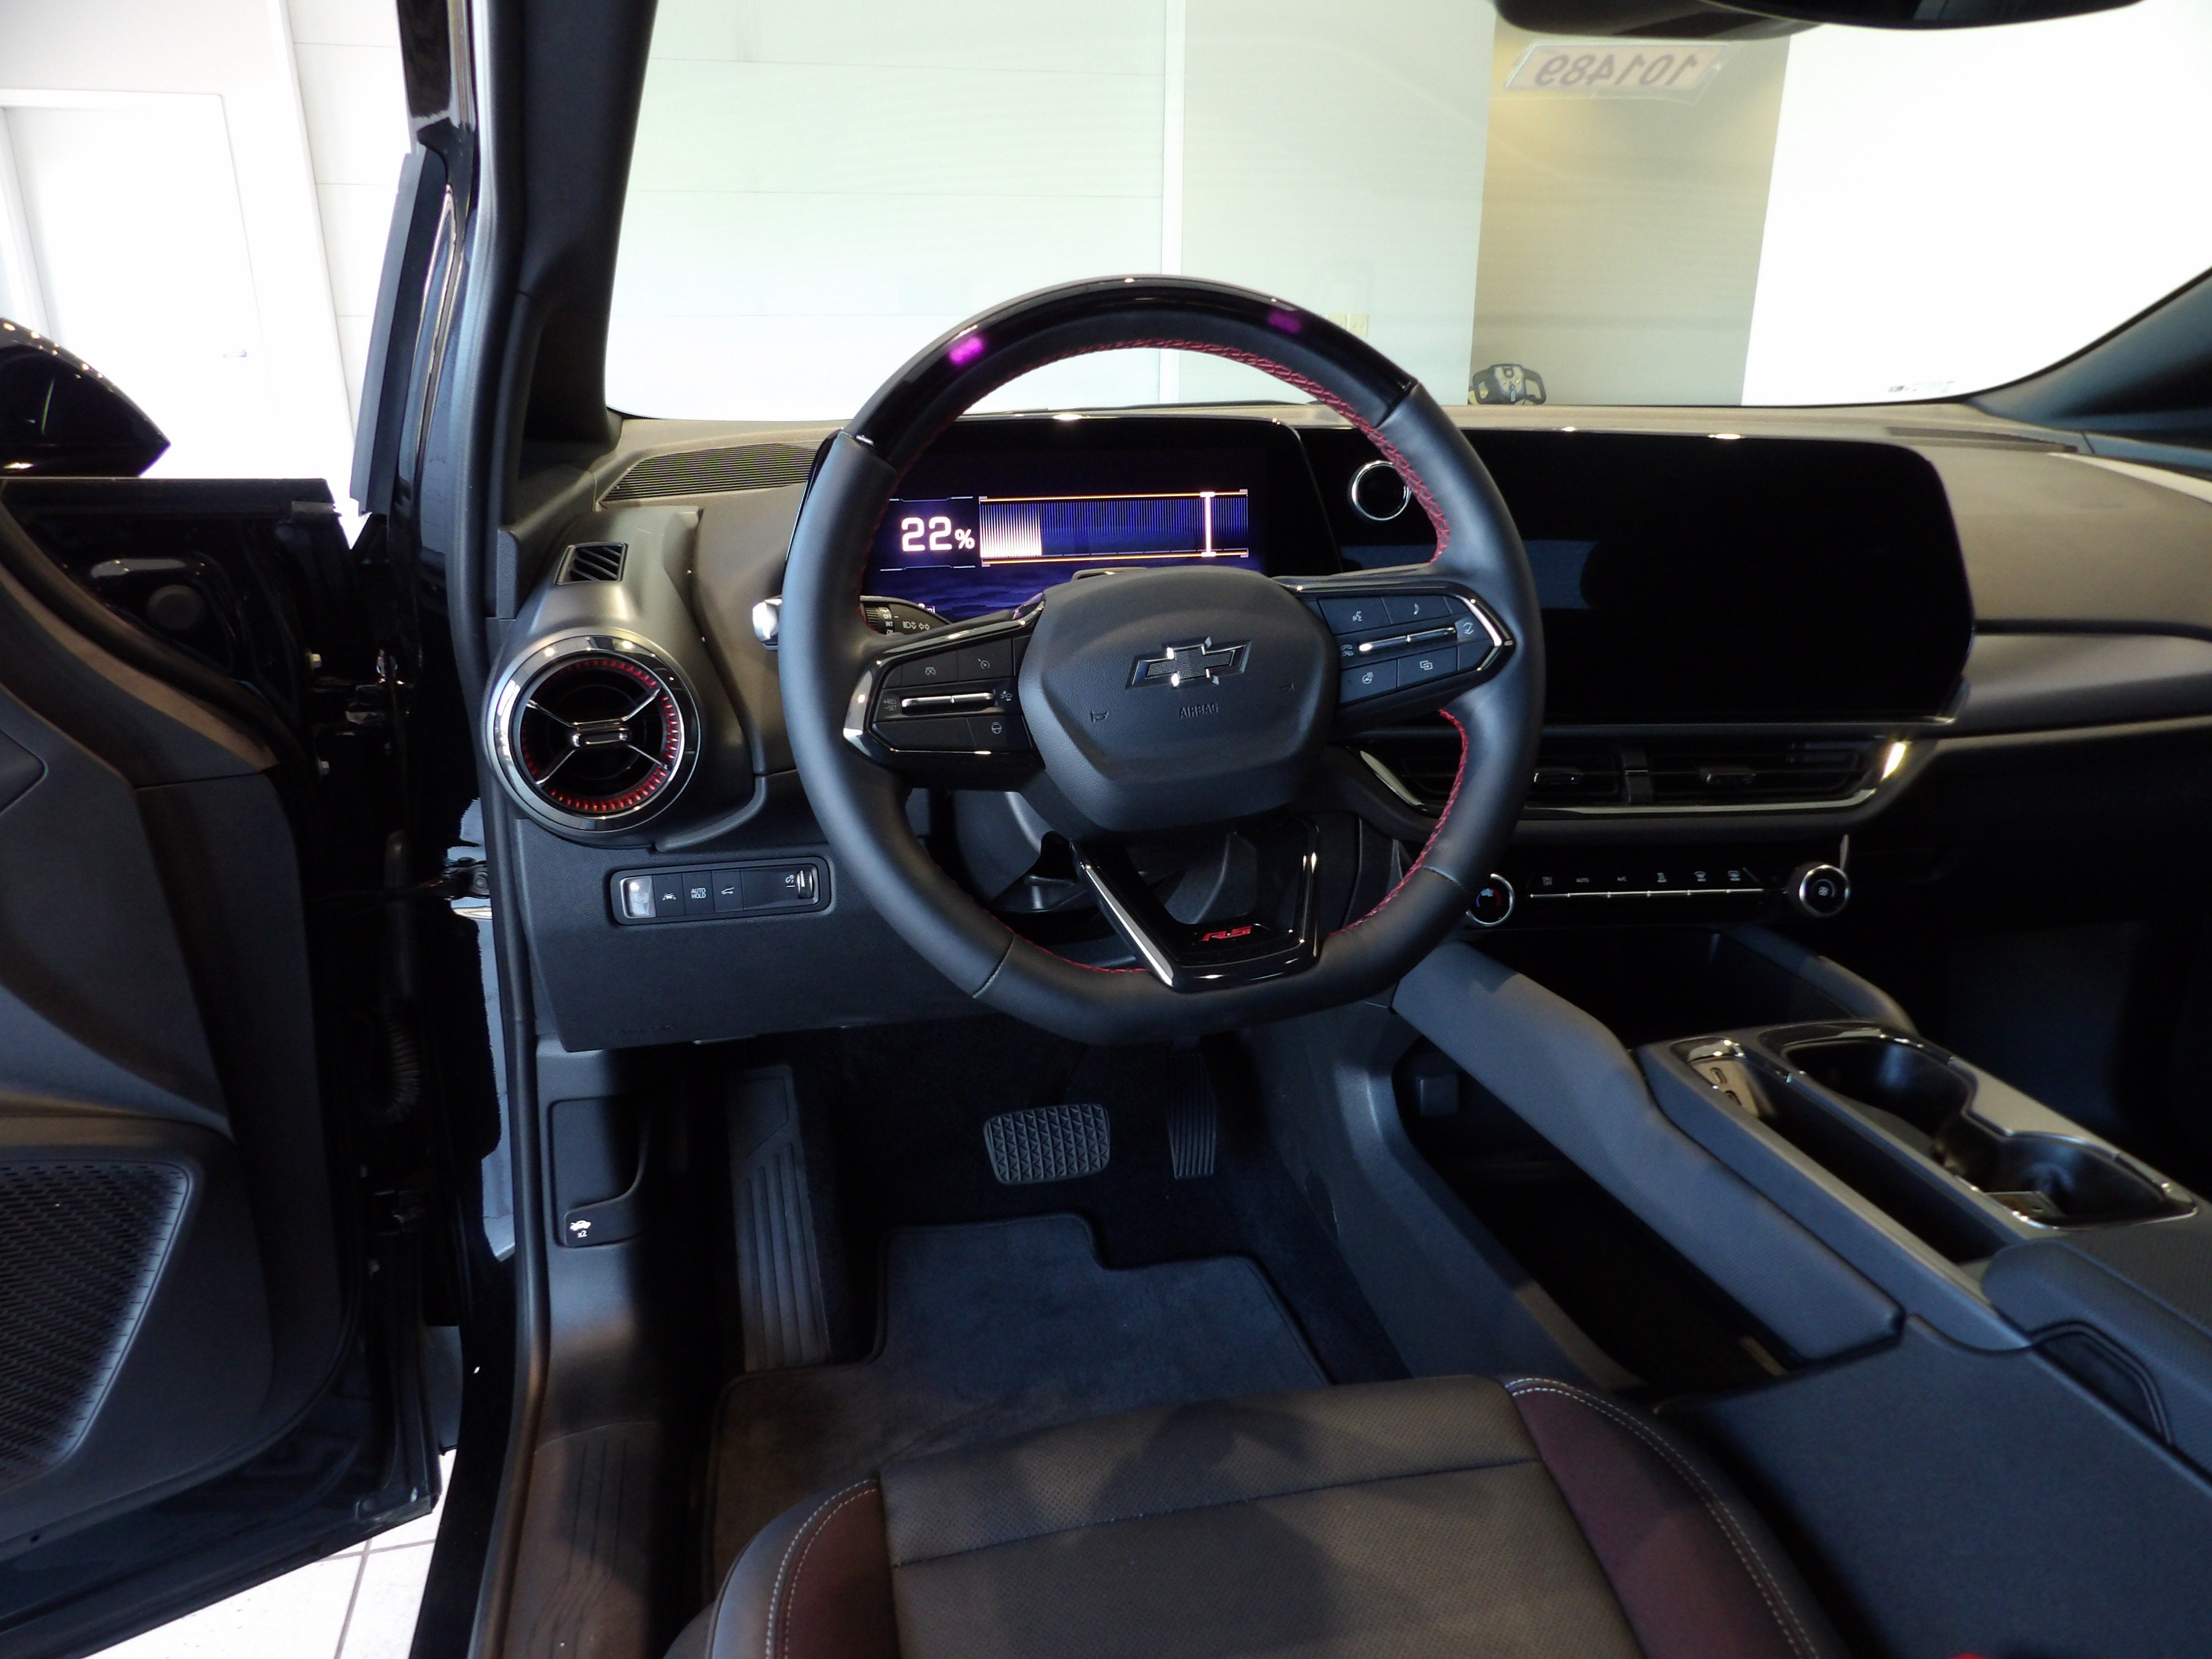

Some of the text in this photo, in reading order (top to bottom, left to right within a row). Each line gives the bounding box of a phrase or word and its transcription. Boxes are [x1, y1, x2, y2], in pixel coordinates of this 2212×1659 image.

[901, 517, 974, 552] 22%
[1179, 703, 1219, 718] AIRBAG
[1202, 926, 1252, 941] RS
